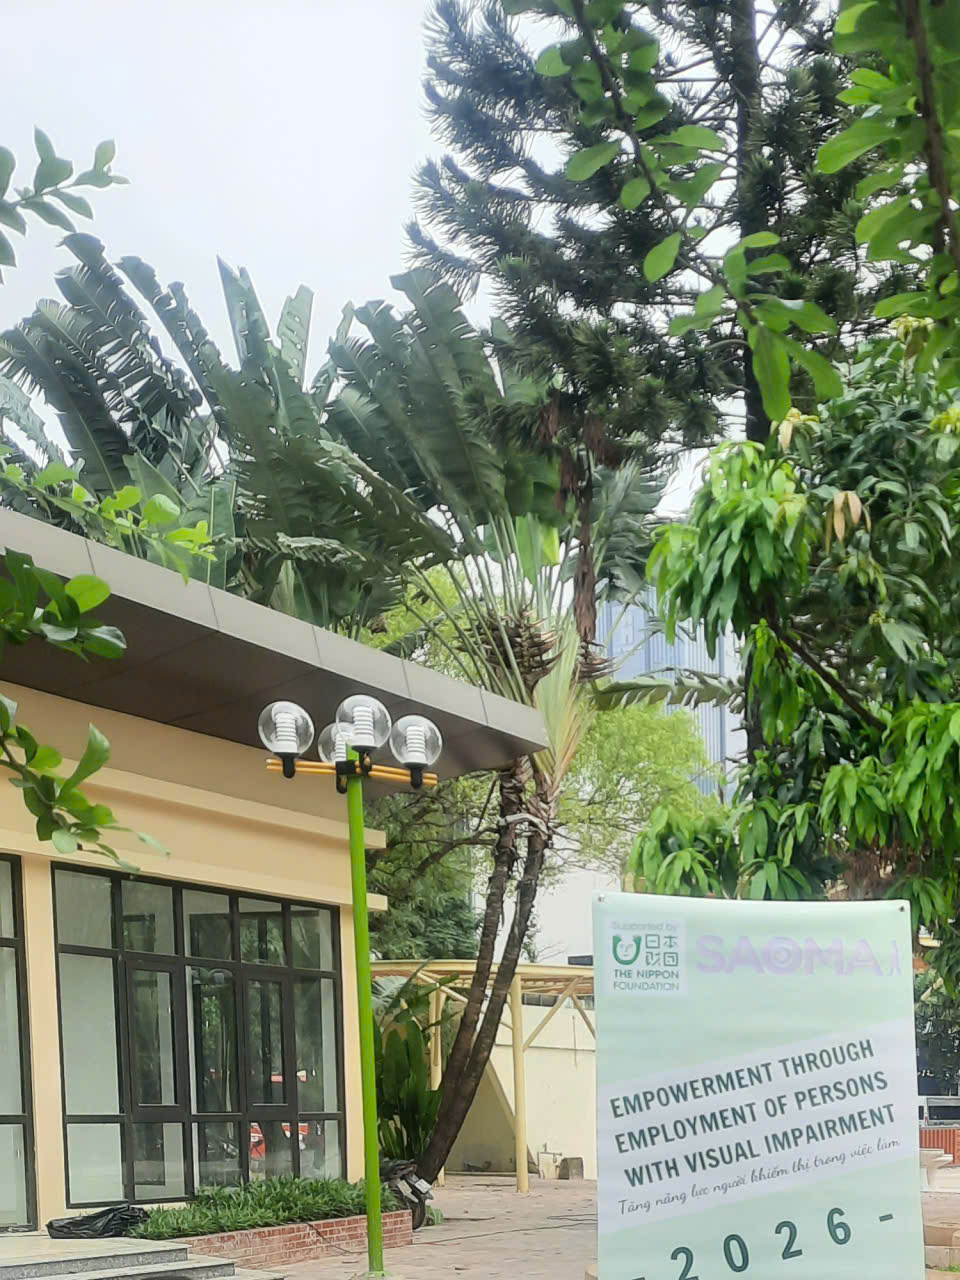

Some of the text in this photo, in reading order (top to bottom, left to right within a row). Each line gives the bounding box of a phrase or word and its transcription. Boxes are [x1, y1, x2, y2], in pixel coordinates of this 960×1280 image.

[613, 981, 679, 991] FOUNDATION
[614, 969, 679, 979] THE NIPPON
[610, 1039, 874, 1118] EMPOWERMENT THROUGH
[615, 1071, 888, 1154] EMPLOYMENT OF PERSONS
[624, 1103, 895, 1188] WITH VISUAL IMPAIRMENT
[814, 1152, 847, 1165] trong
